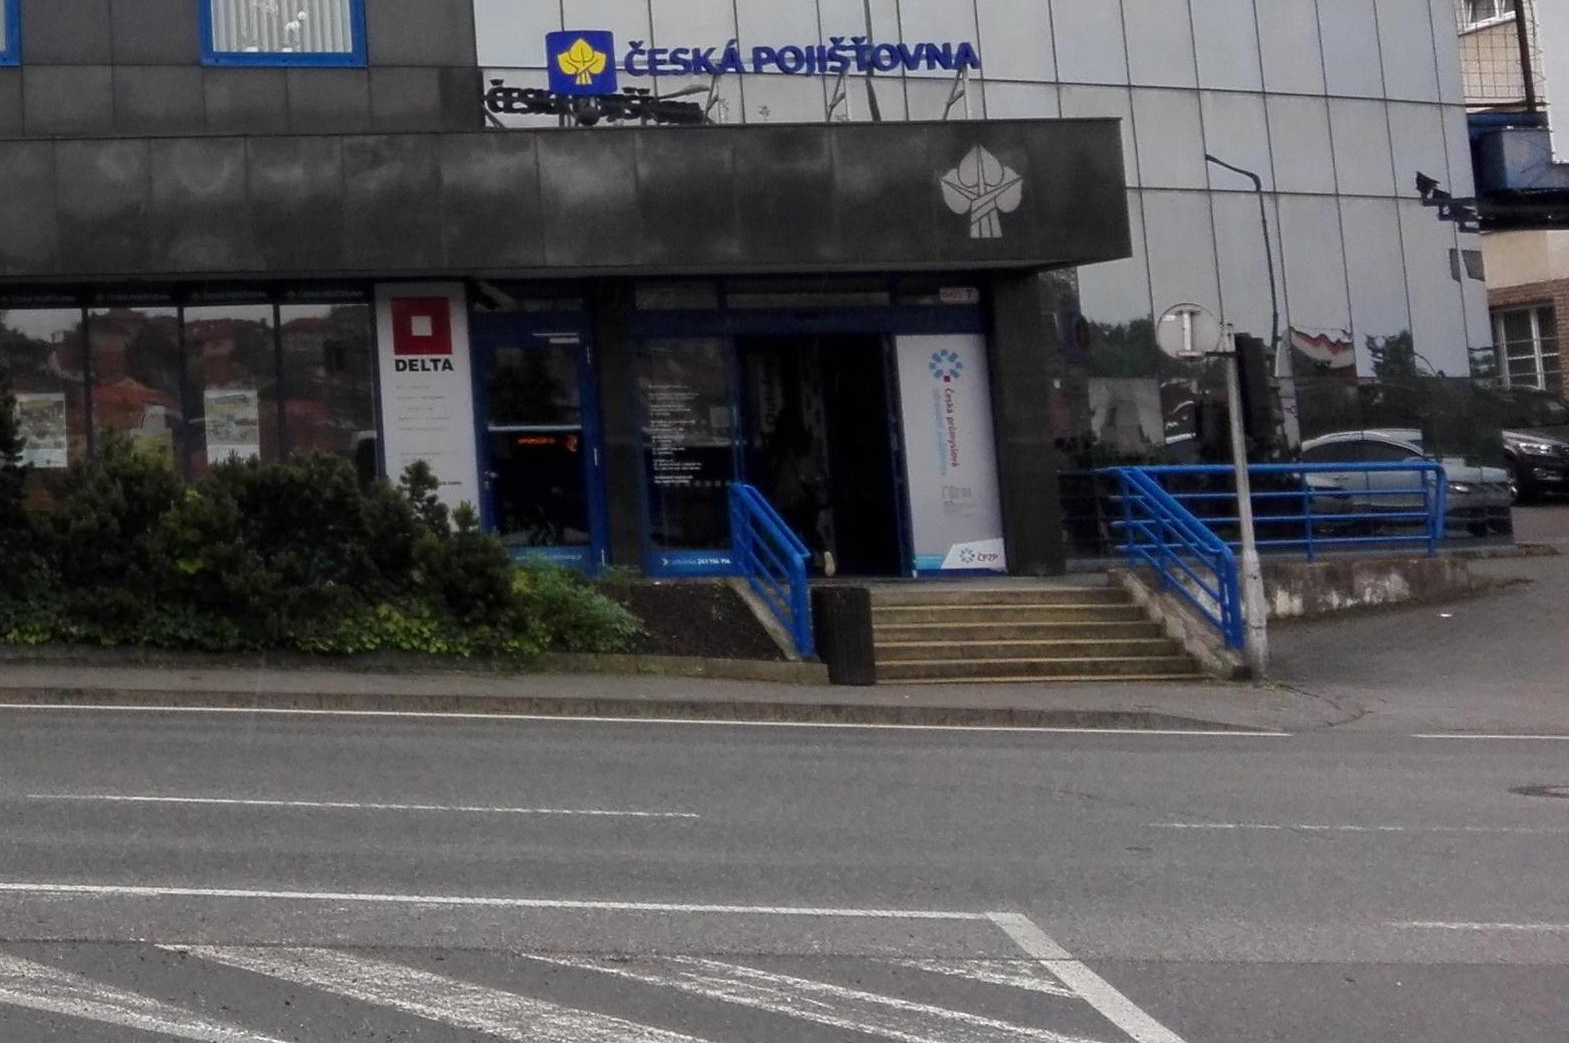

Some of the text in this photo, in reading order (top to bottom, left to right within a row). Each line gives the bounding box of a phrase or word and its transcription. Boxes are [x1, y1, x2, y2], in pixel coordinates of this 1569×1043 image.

[624, 36, 981, 77] ČESKÁ POJIŠŤOVNA
[394, 358, 454, 373] DELTA
